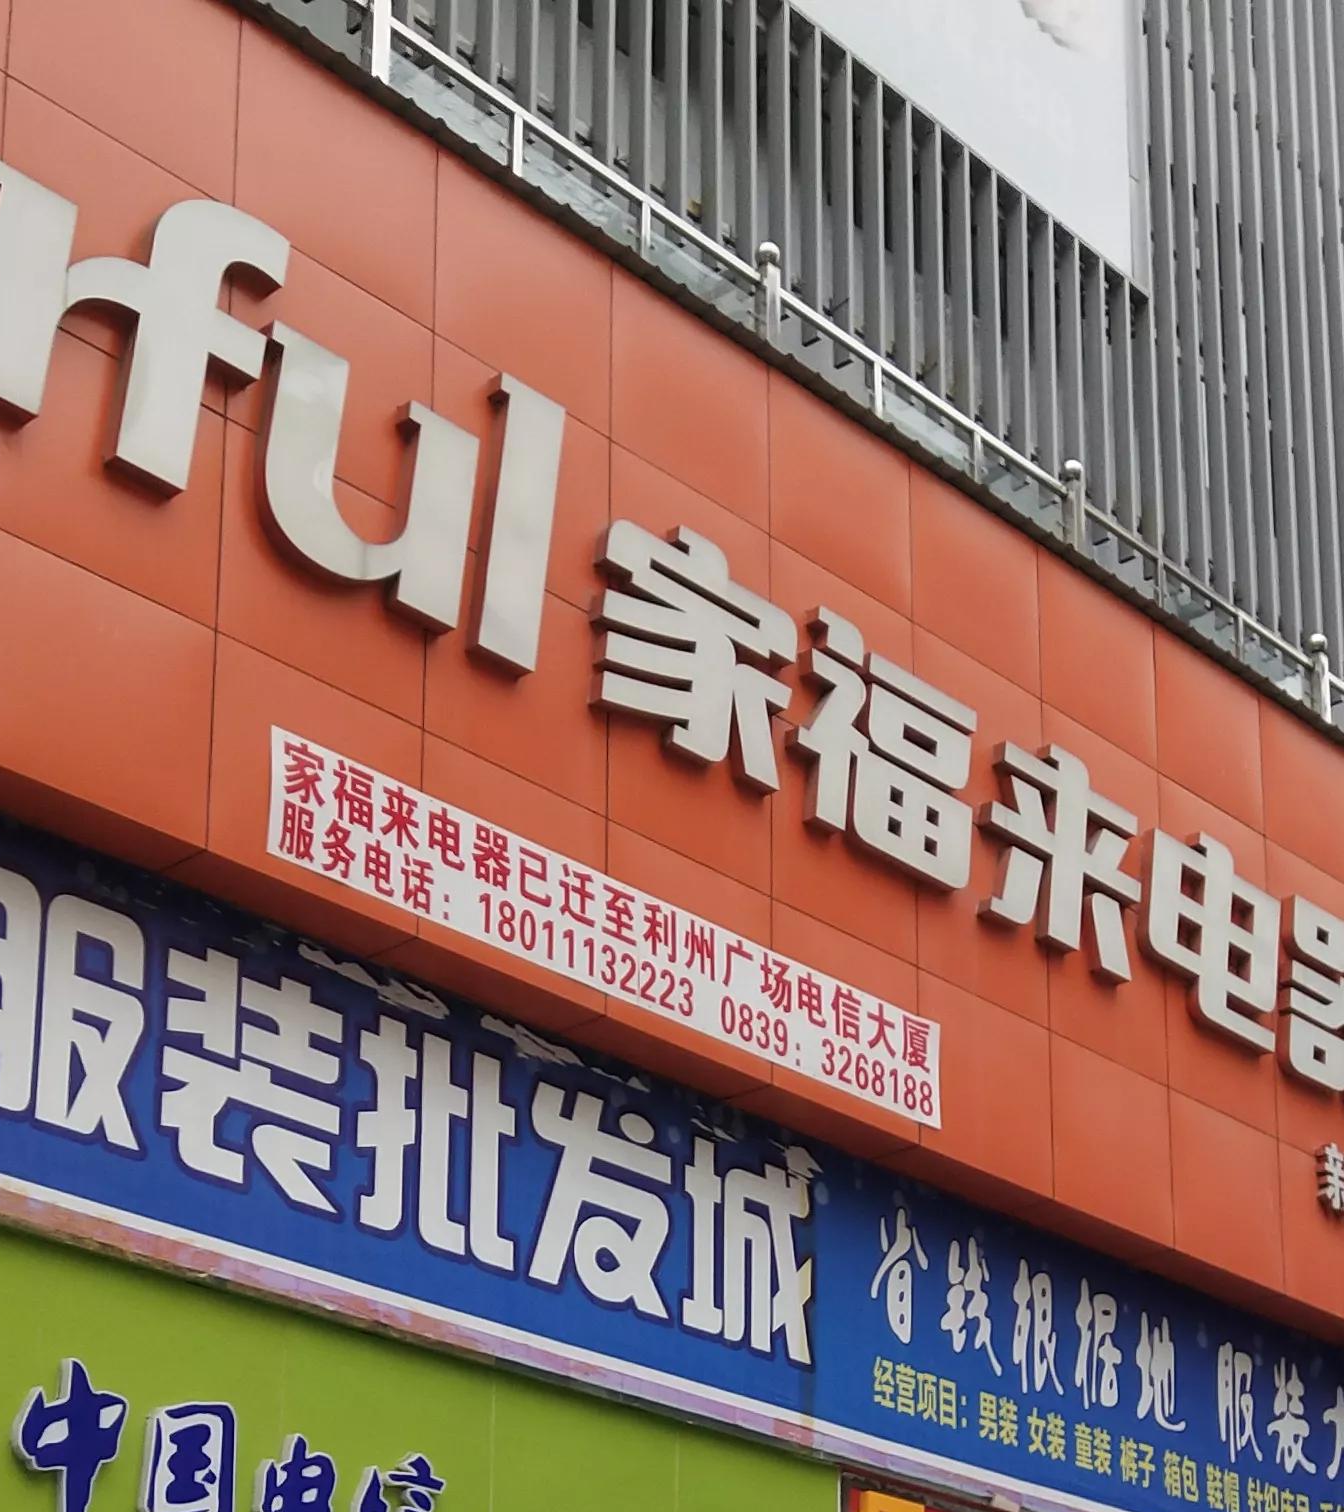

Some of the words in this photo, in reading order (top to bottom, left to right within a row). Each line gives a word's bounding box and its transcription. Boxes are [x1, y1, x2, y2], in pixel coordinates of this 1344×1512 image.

[281, 738, 934, 1076] 家福来电器已迁至利州广场电信大厦
[870, 1206, 1187, 1433] 省钱根据地
[977, 1390, 1020, 1449] 男装
[1026, 1404, 1067, 1463] 女装
[1073, 1420, 1113, 1478] 童装
[1118, 1435, 1156, 1490] 裤子
[1163, 1449, 1200, 1504] 箱包
